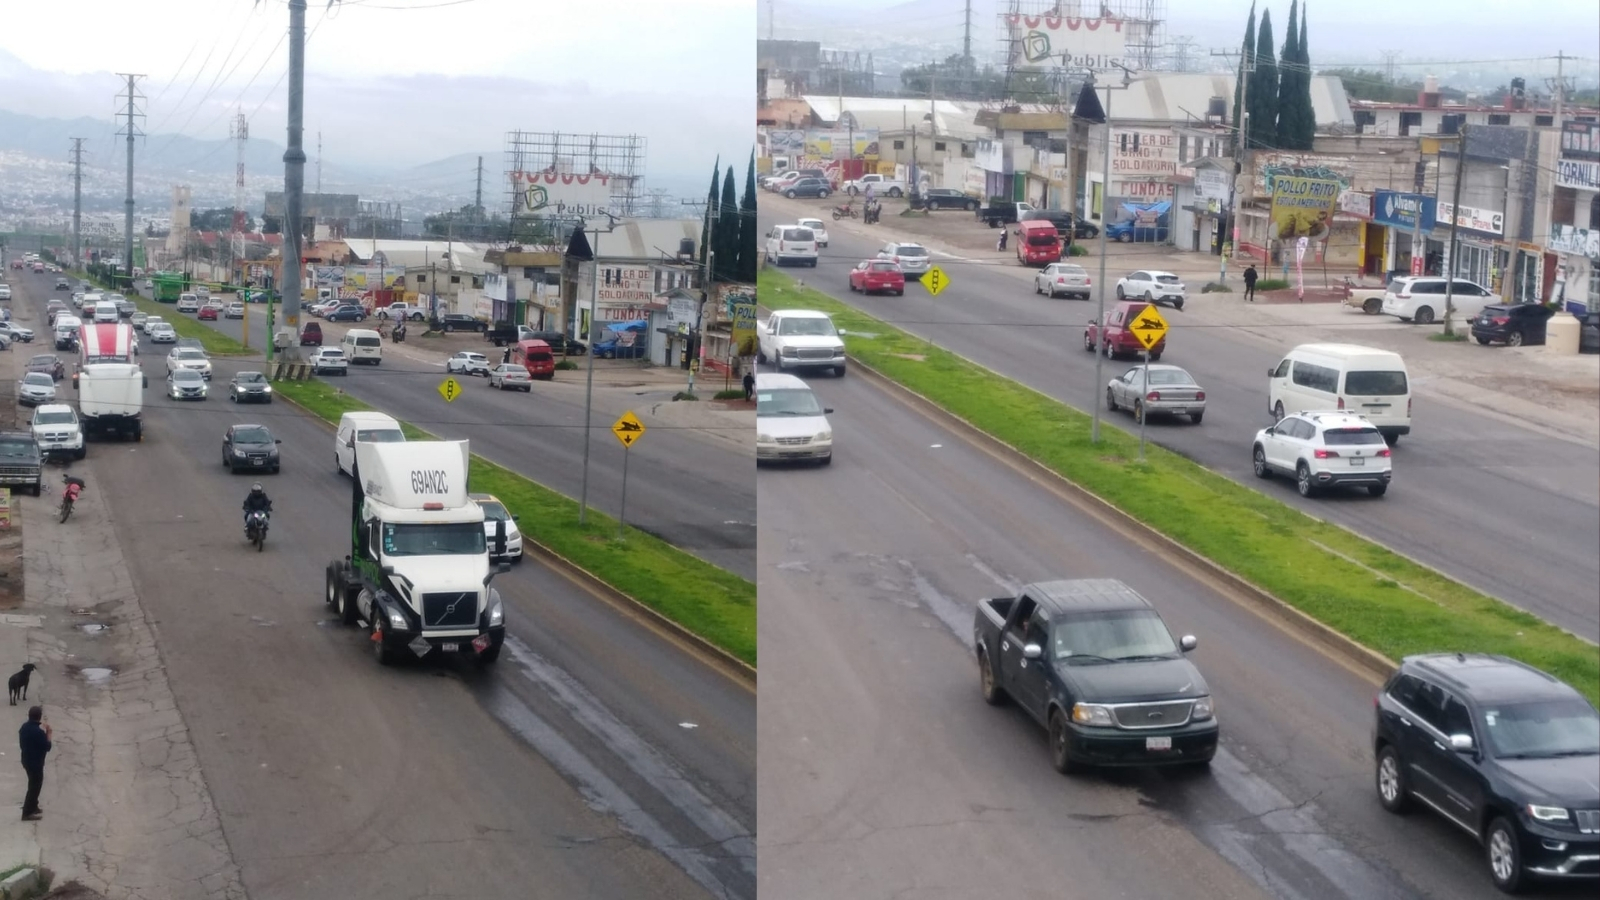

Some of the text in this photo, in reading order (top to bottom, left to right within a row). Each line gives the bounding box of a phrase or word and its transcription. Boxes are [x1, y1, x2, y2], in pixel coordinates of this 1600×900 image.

[1160, 135, 1173, 146] DE
[1121, 182, 1174, 197] FUNDAS
[1277, 180, 1336, 197] POLLO FRITO
[638, 270, 649, 279] DE
[605, 308, 650, 321] FUNDAS
[410, 469, 449, 495] 69AN2C
